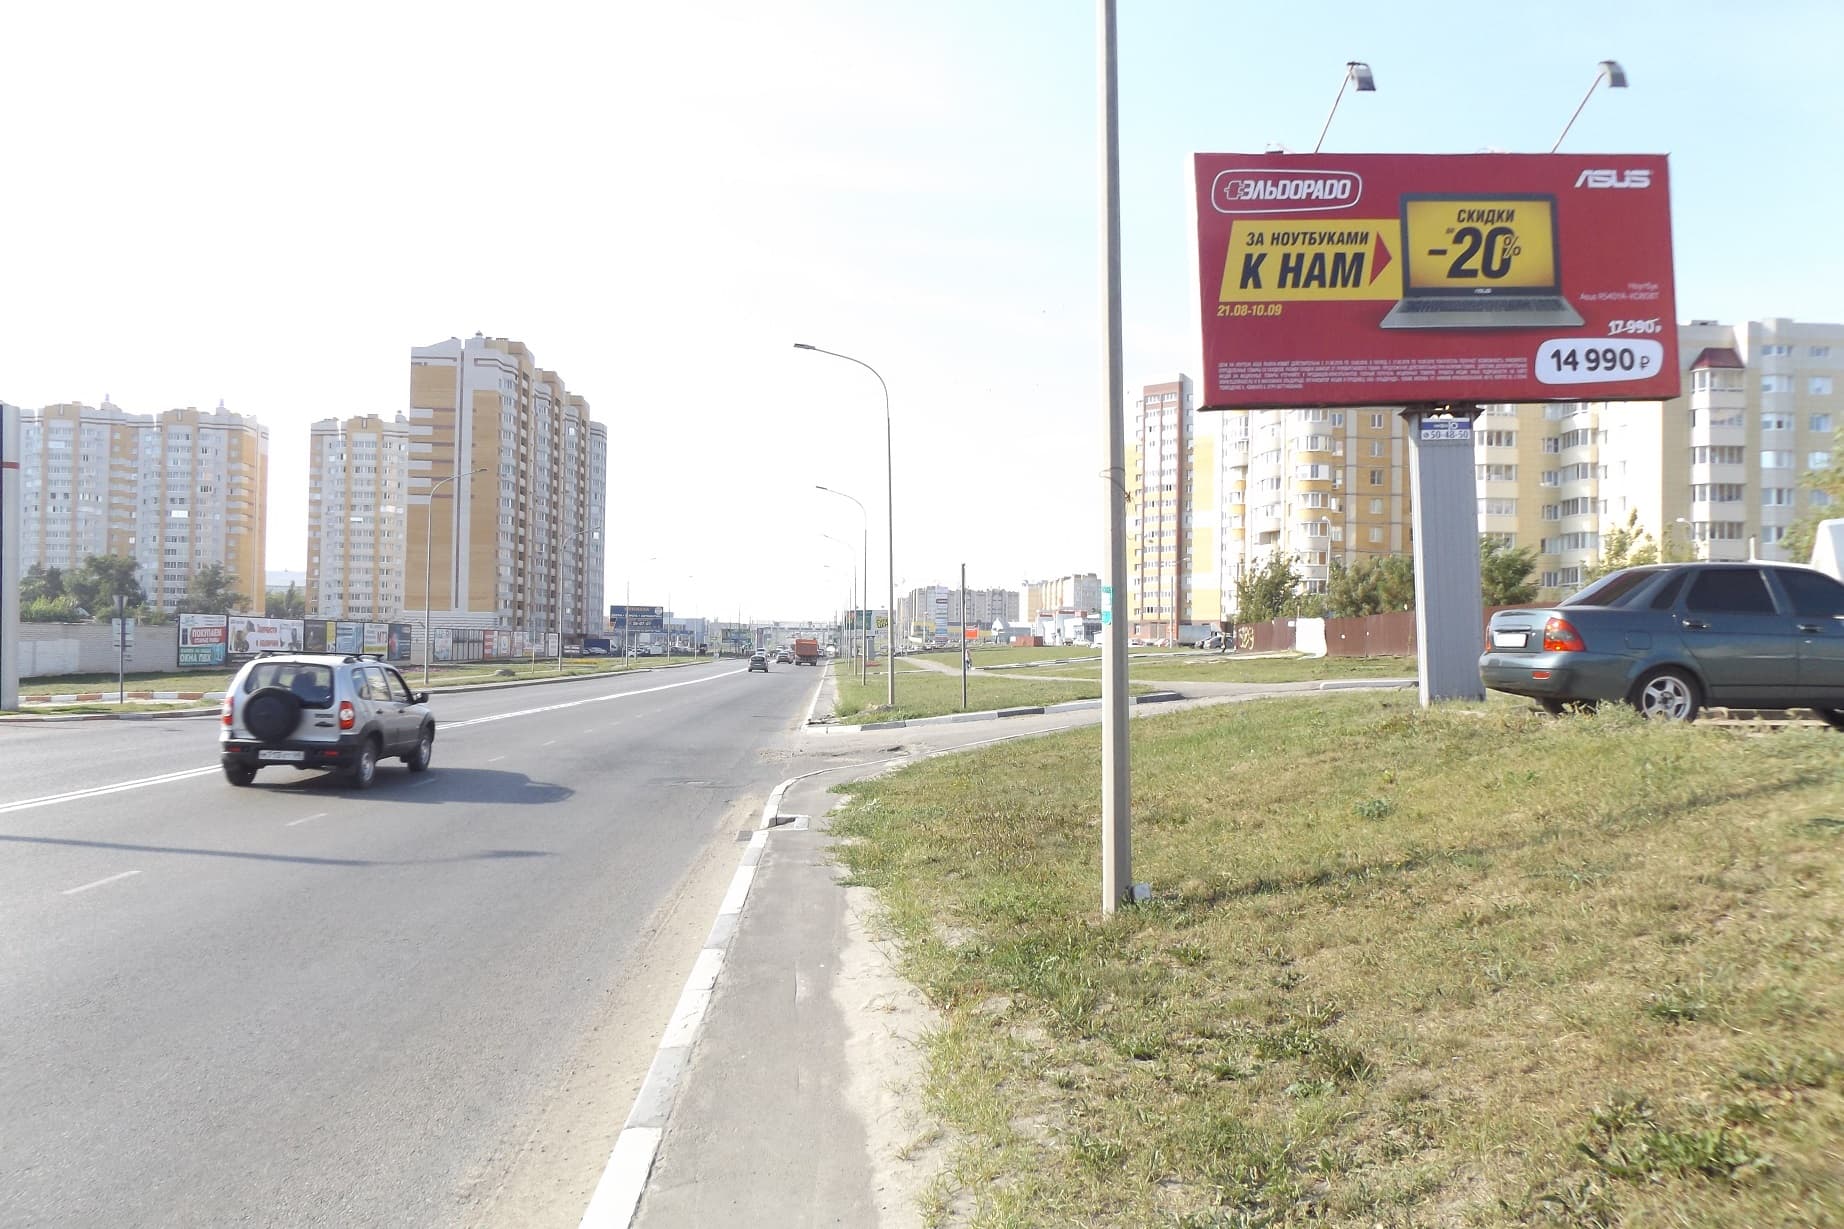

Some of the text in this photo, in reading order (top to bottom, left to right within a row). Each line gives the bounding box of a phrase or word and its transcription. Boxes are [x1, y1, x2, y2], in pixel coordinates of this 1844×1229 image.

[1573, 168, 1651, 189] ASUS
[1456, 208, 1516, 225] СКИДКИ
[1246, 231, 1369, 246] ЗА НОУТБУКАМИ
[1239, 251, 1366, 289] К НАМ
[1216, 303, 1282, 317] 21.08-10.09
[1550, 348, 1579, 372] 14
[1584, 347, 1635, 372] 990
